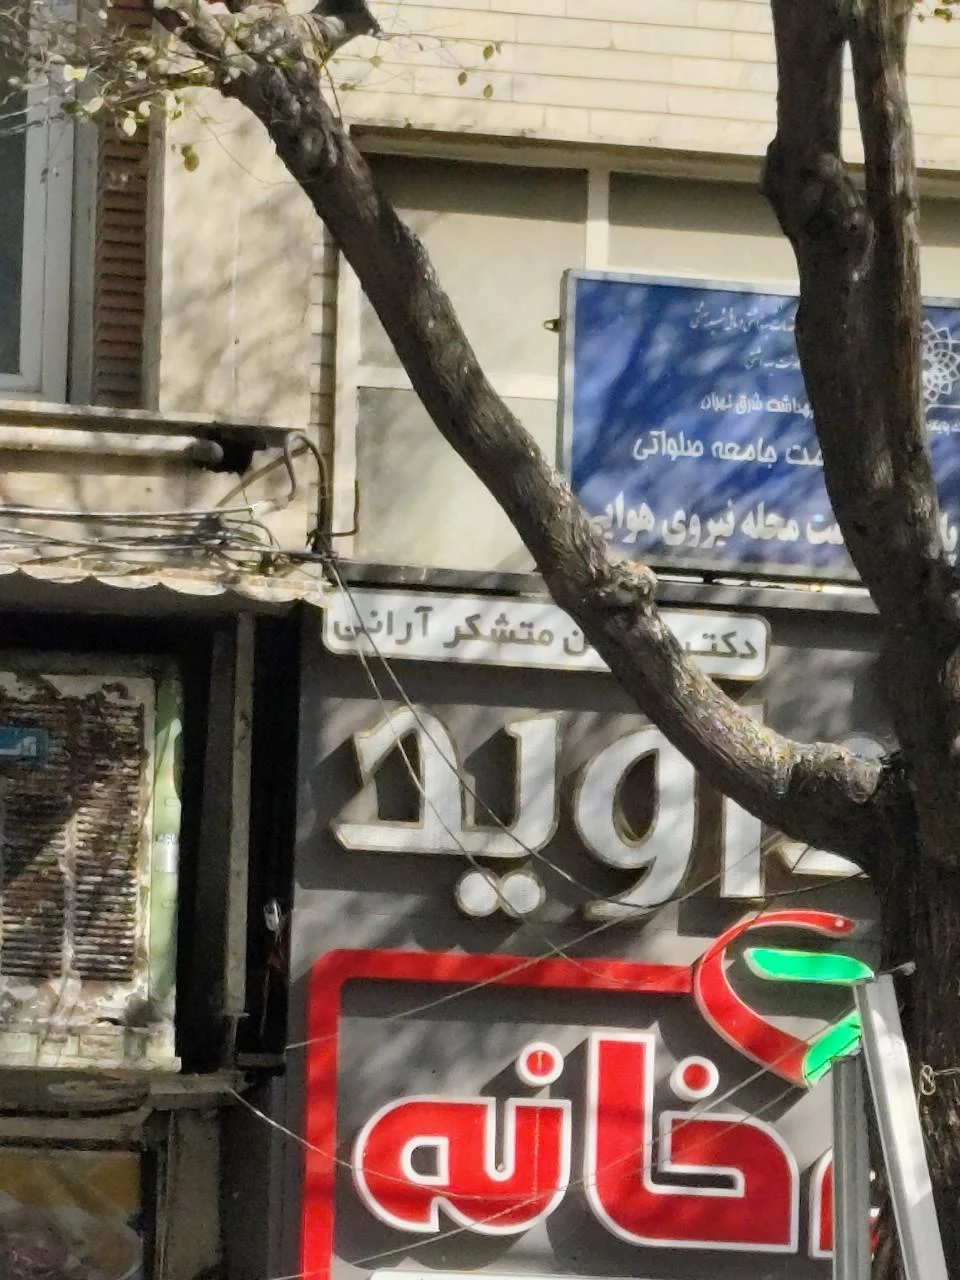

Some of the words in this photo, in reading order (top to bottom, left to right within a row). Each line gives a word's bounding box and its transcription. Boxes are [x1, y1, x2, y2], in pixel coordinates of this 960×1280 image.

[632, 429, 705, 463] صلواتی
[711, 436, 779, 470] جامعه
[661, 498, 736, 550] نیروی
[740, 500, 801, 543] محله
[332, 605, 434, 647] آرانی
[443, 611, 555, 650] متشکر
[684, 629, 760, 661] دکت
